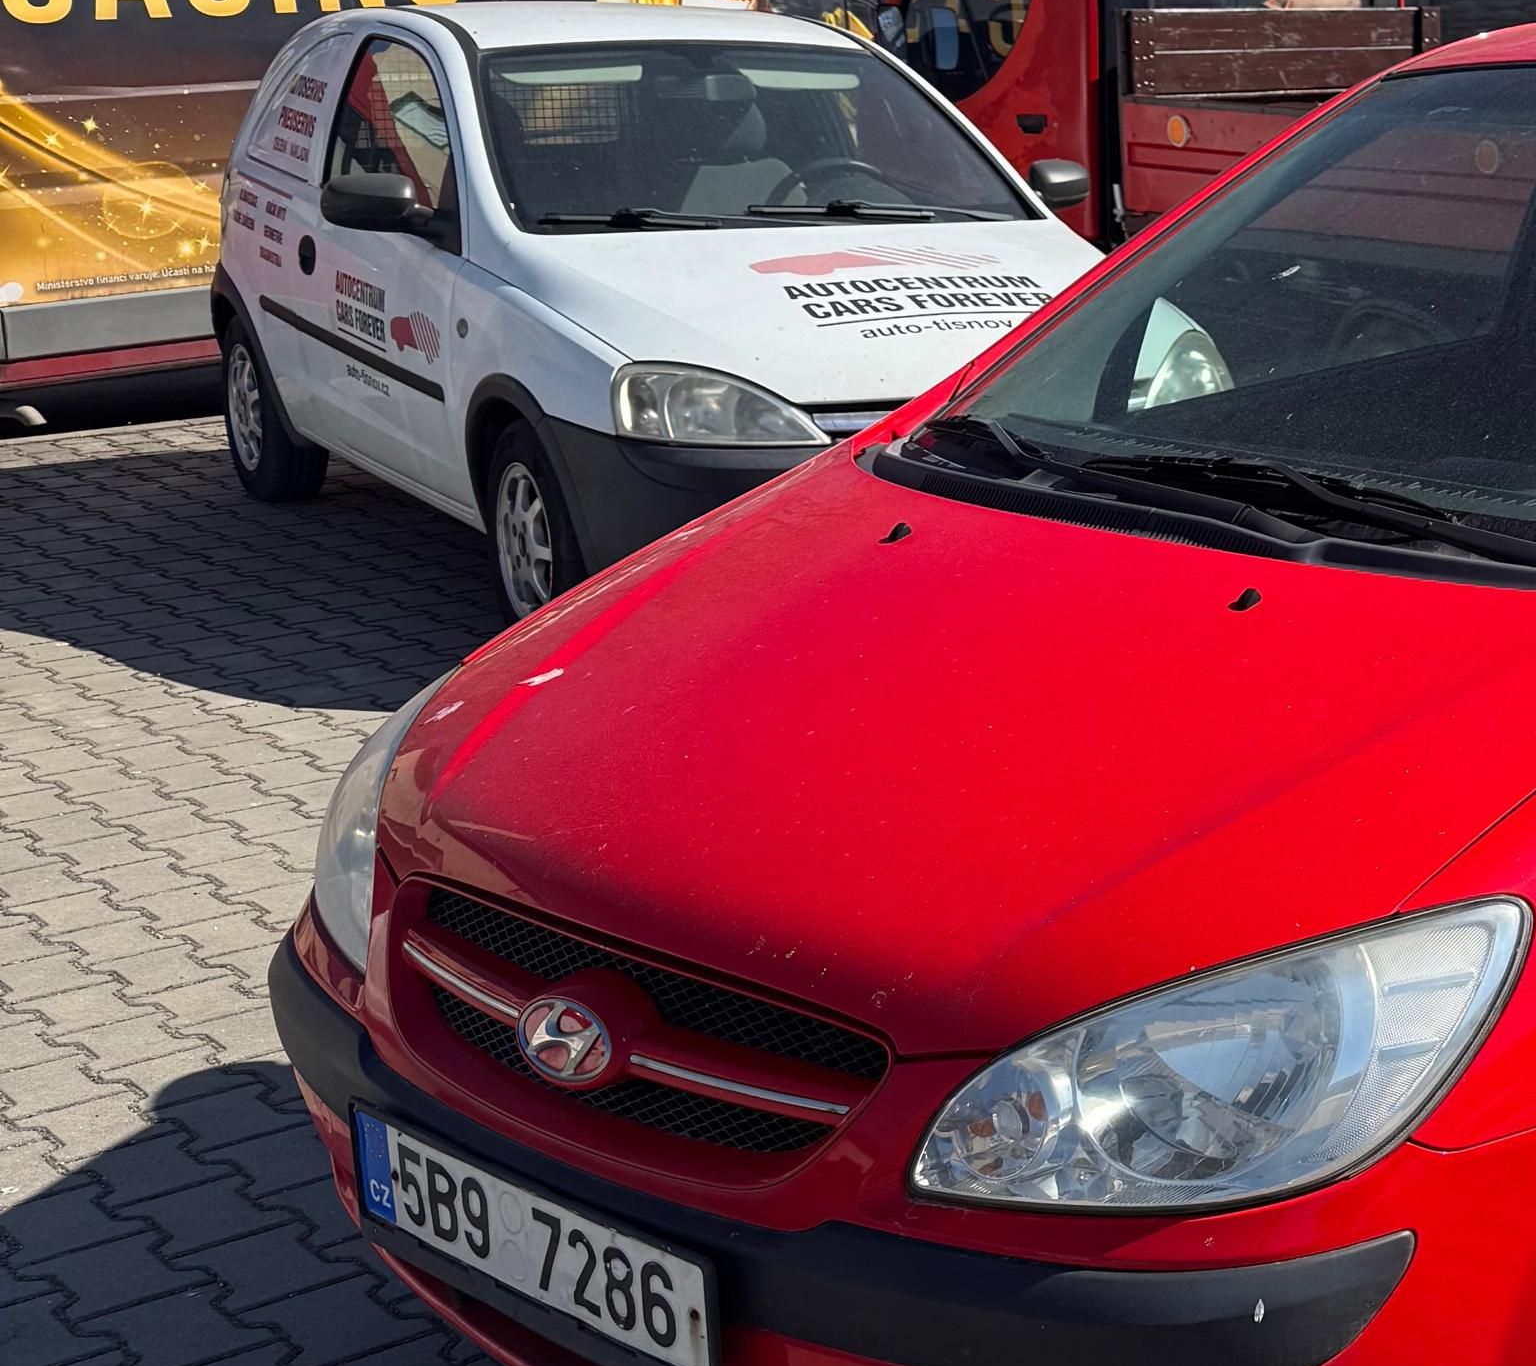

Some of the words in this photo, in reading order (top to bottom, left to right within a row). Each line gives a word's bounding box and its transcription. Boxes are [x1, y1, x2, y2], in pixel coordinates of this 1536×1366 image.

[192, 264, 203, 275] na
[335, 270, 386, 313] AUTOCENTRUM
[783, 275, 1042, 300] AUTOCENTRUM
[335, 298, 356, 328] CARS
[355, 307, 386, 344] FOREVER
[802, 297, 902, 319] CARS
[370, 1178, 392, 1208] CZ
[397, 1142, 491, 1260] 5B9
[531, 1206, 677, 1348] 7286
